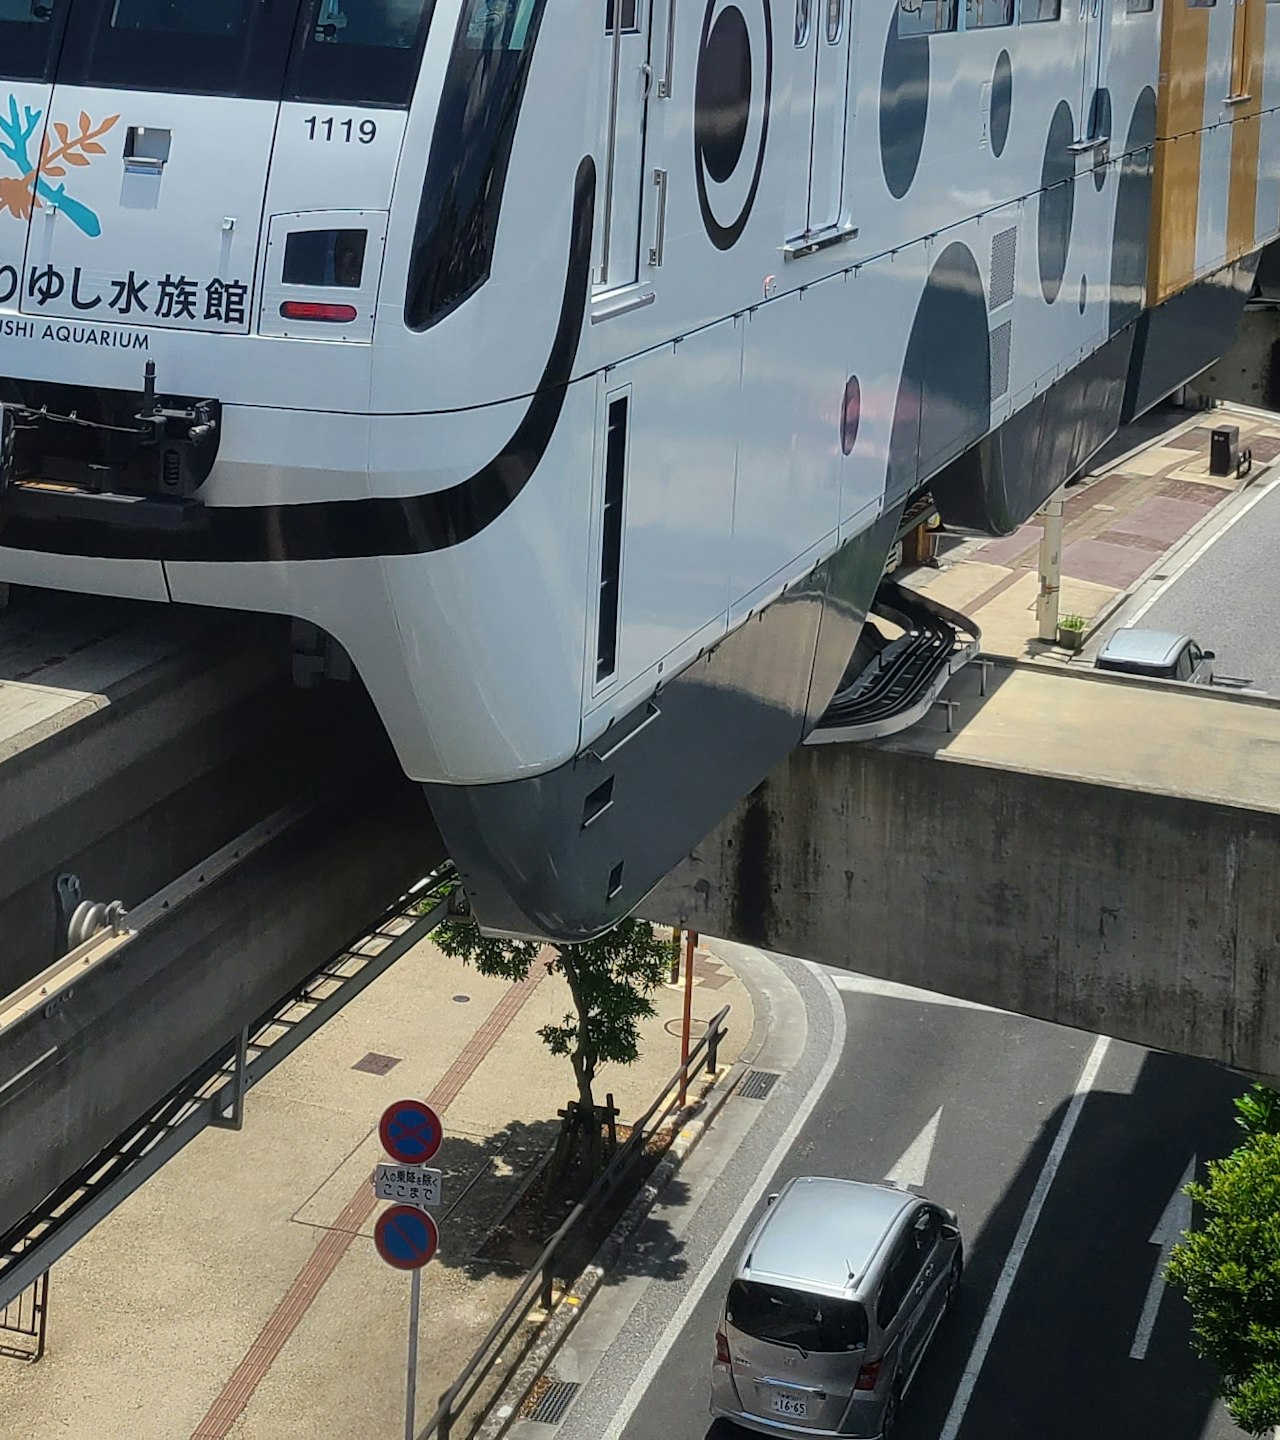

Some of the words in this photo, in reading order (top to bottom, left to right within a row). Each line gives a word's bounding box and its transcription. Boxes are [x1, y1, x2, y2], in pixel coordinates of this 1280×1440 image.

[304, 115, 377, 145] 1119
[41, 324, 150, 351] AQUARIUM
[379, 1168, 439, 1187] 人の乗降を除く
[383, 1183, 433, 1201] ここまで
